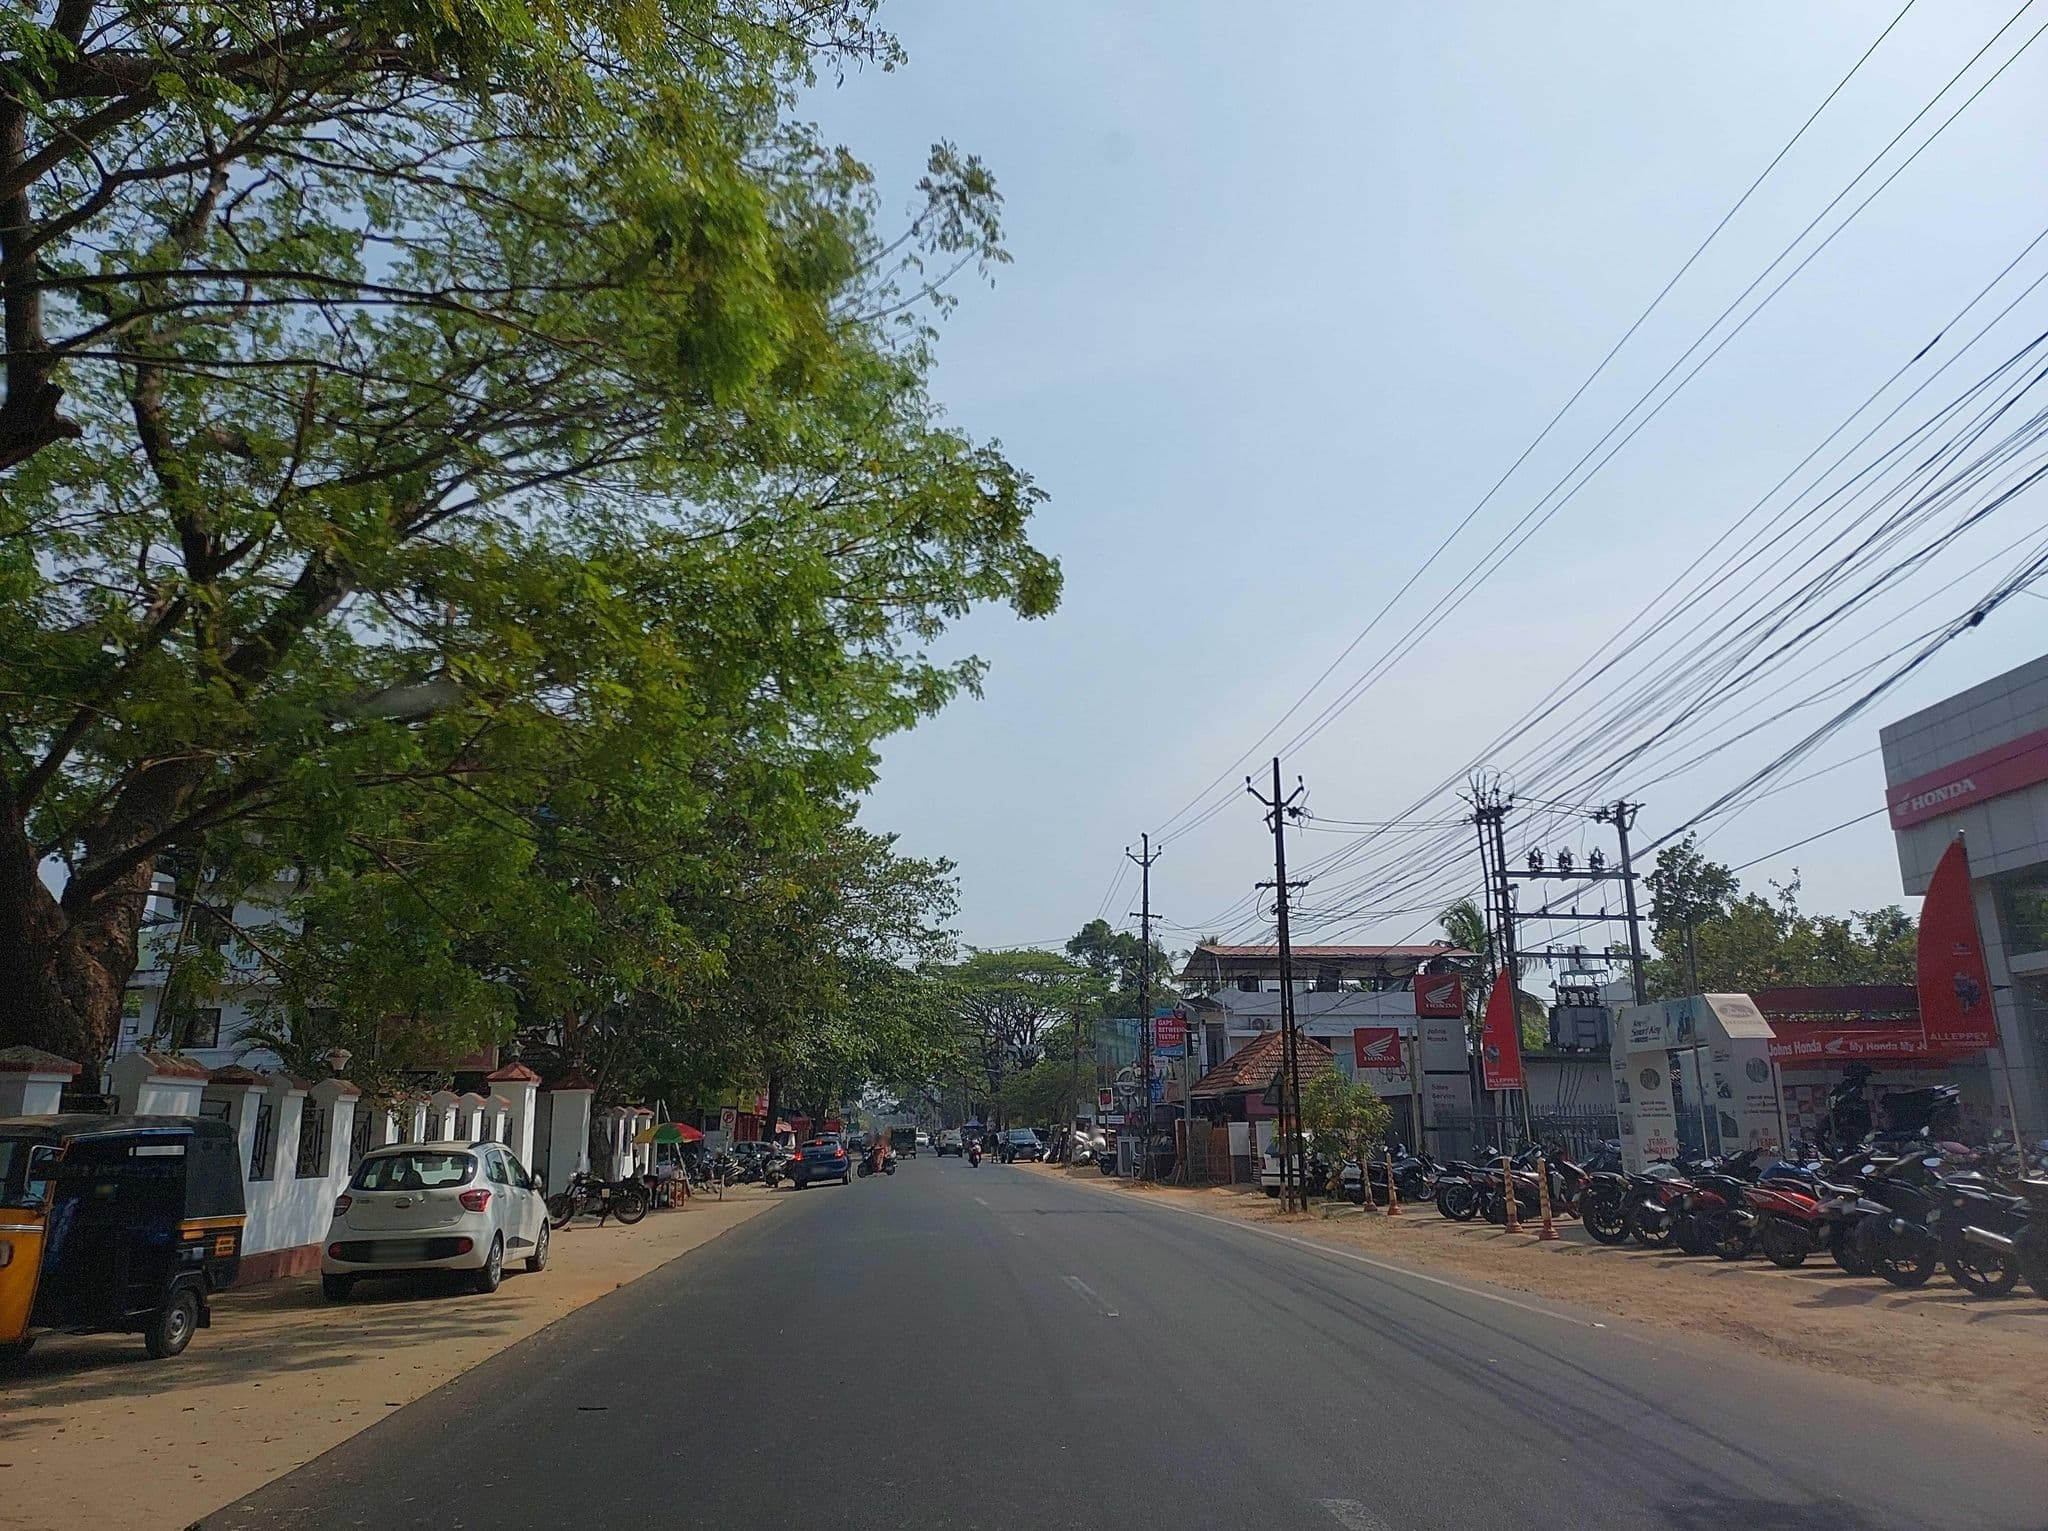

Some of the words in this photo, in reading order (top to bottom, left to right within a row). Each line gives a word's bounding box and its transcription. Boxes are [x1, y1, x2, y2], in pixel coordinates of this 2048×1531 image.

[1912, 778, 1976, 810] HONDA
[1930, 1031, 1989, 1041] ALLEPPEY
[1769, 1041, 1793, 1057] Johns
[1794, 1039, 1822, 1056] Honda
[1849, 1041, 1864, 1053] My
[1866, 1041, 1898, 1051] Honda
[1900, 1041, 1914, 1052] My
